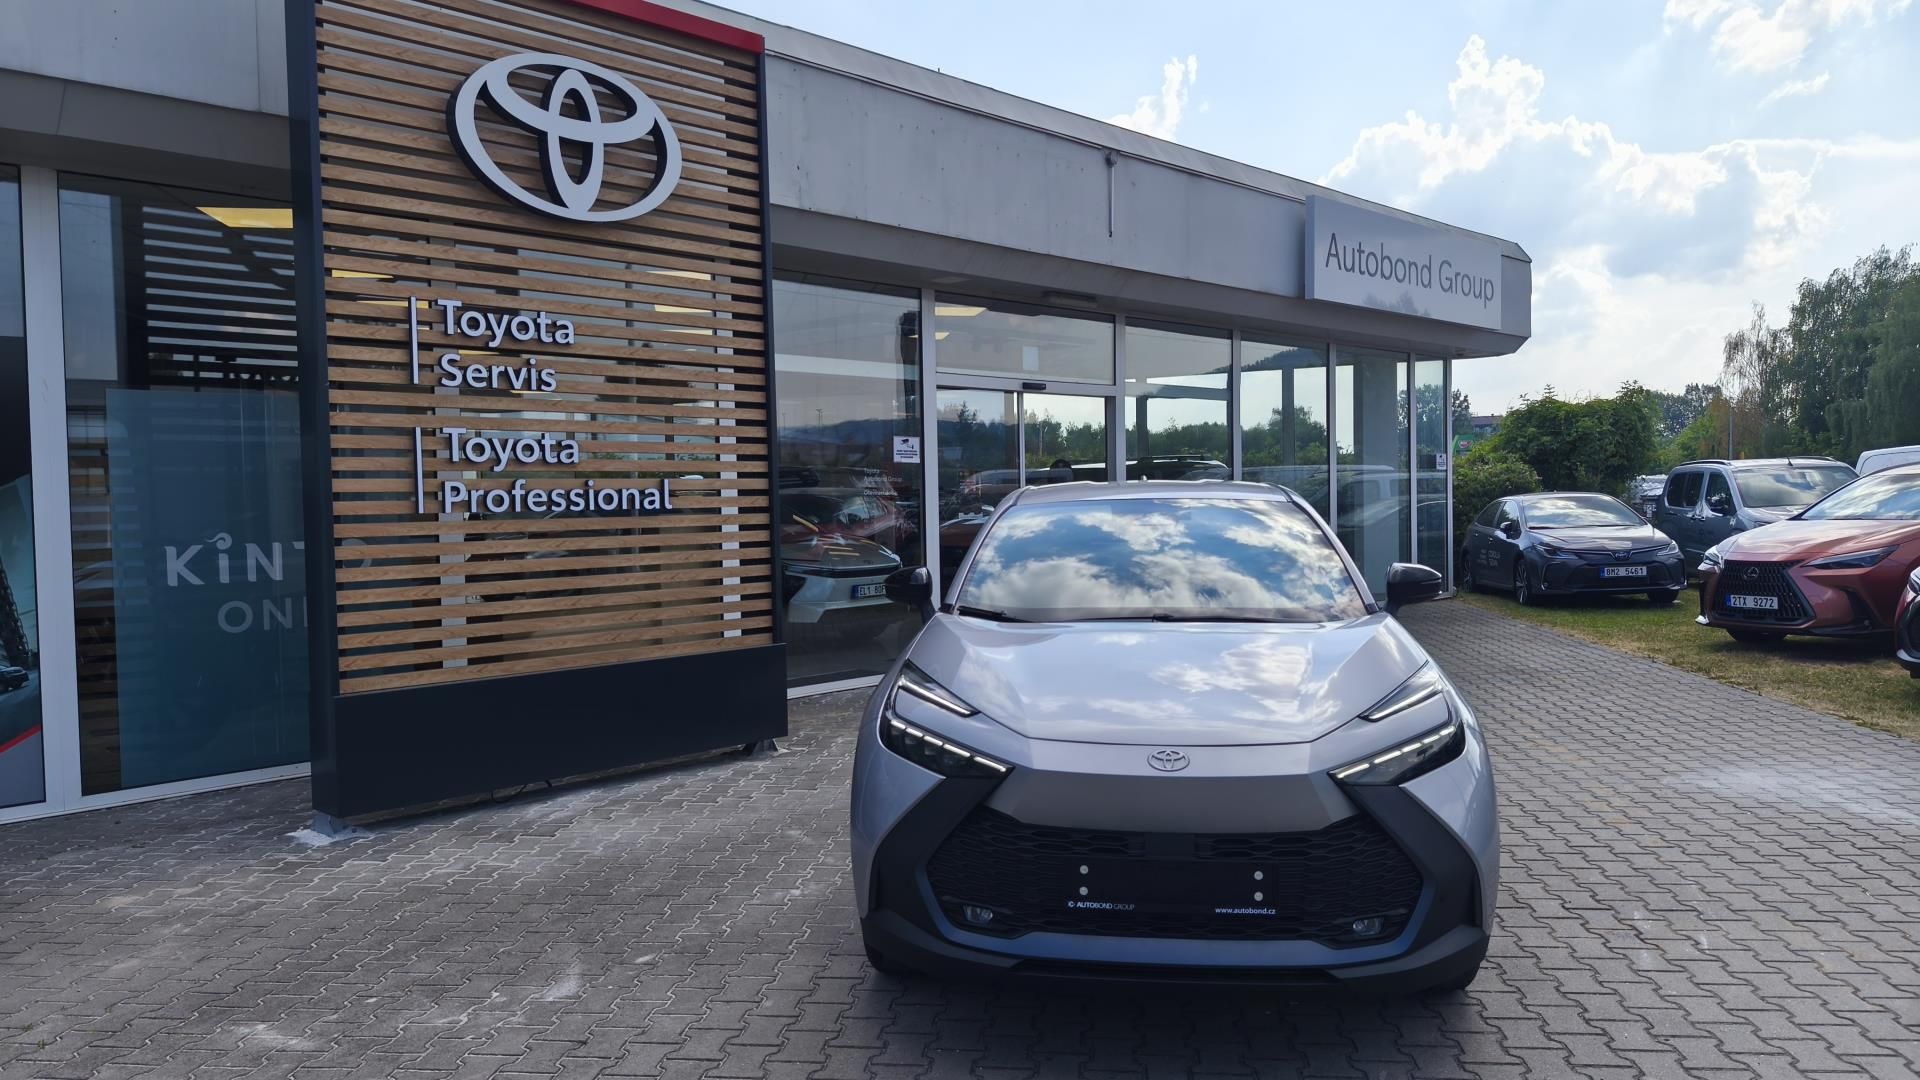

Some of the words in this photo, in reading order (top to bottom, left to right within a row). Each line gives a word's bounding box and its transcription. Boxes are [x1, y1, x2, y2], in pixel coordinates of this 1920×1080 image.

[1325, 232, 1432, 289] Autobond
[1438, 260, 1495, 309] Group
[437, 298, 576, 348] Toyota
[440, 353, 558, 392] Servis
[442, 427, 580, 473] Toyota
[443, 478, 673, 514] Professional
[217, 597, 308, 634] ON
[1732, 596, 1748, 607] 2TX
[1752, 597, 1775, 608] 9272
[1076, 901, 1113, 910] AUTOBOND
[1113, 903, 1136, 911] GROUP
[1214, 907, 1277, 915] www.autobond.cz
